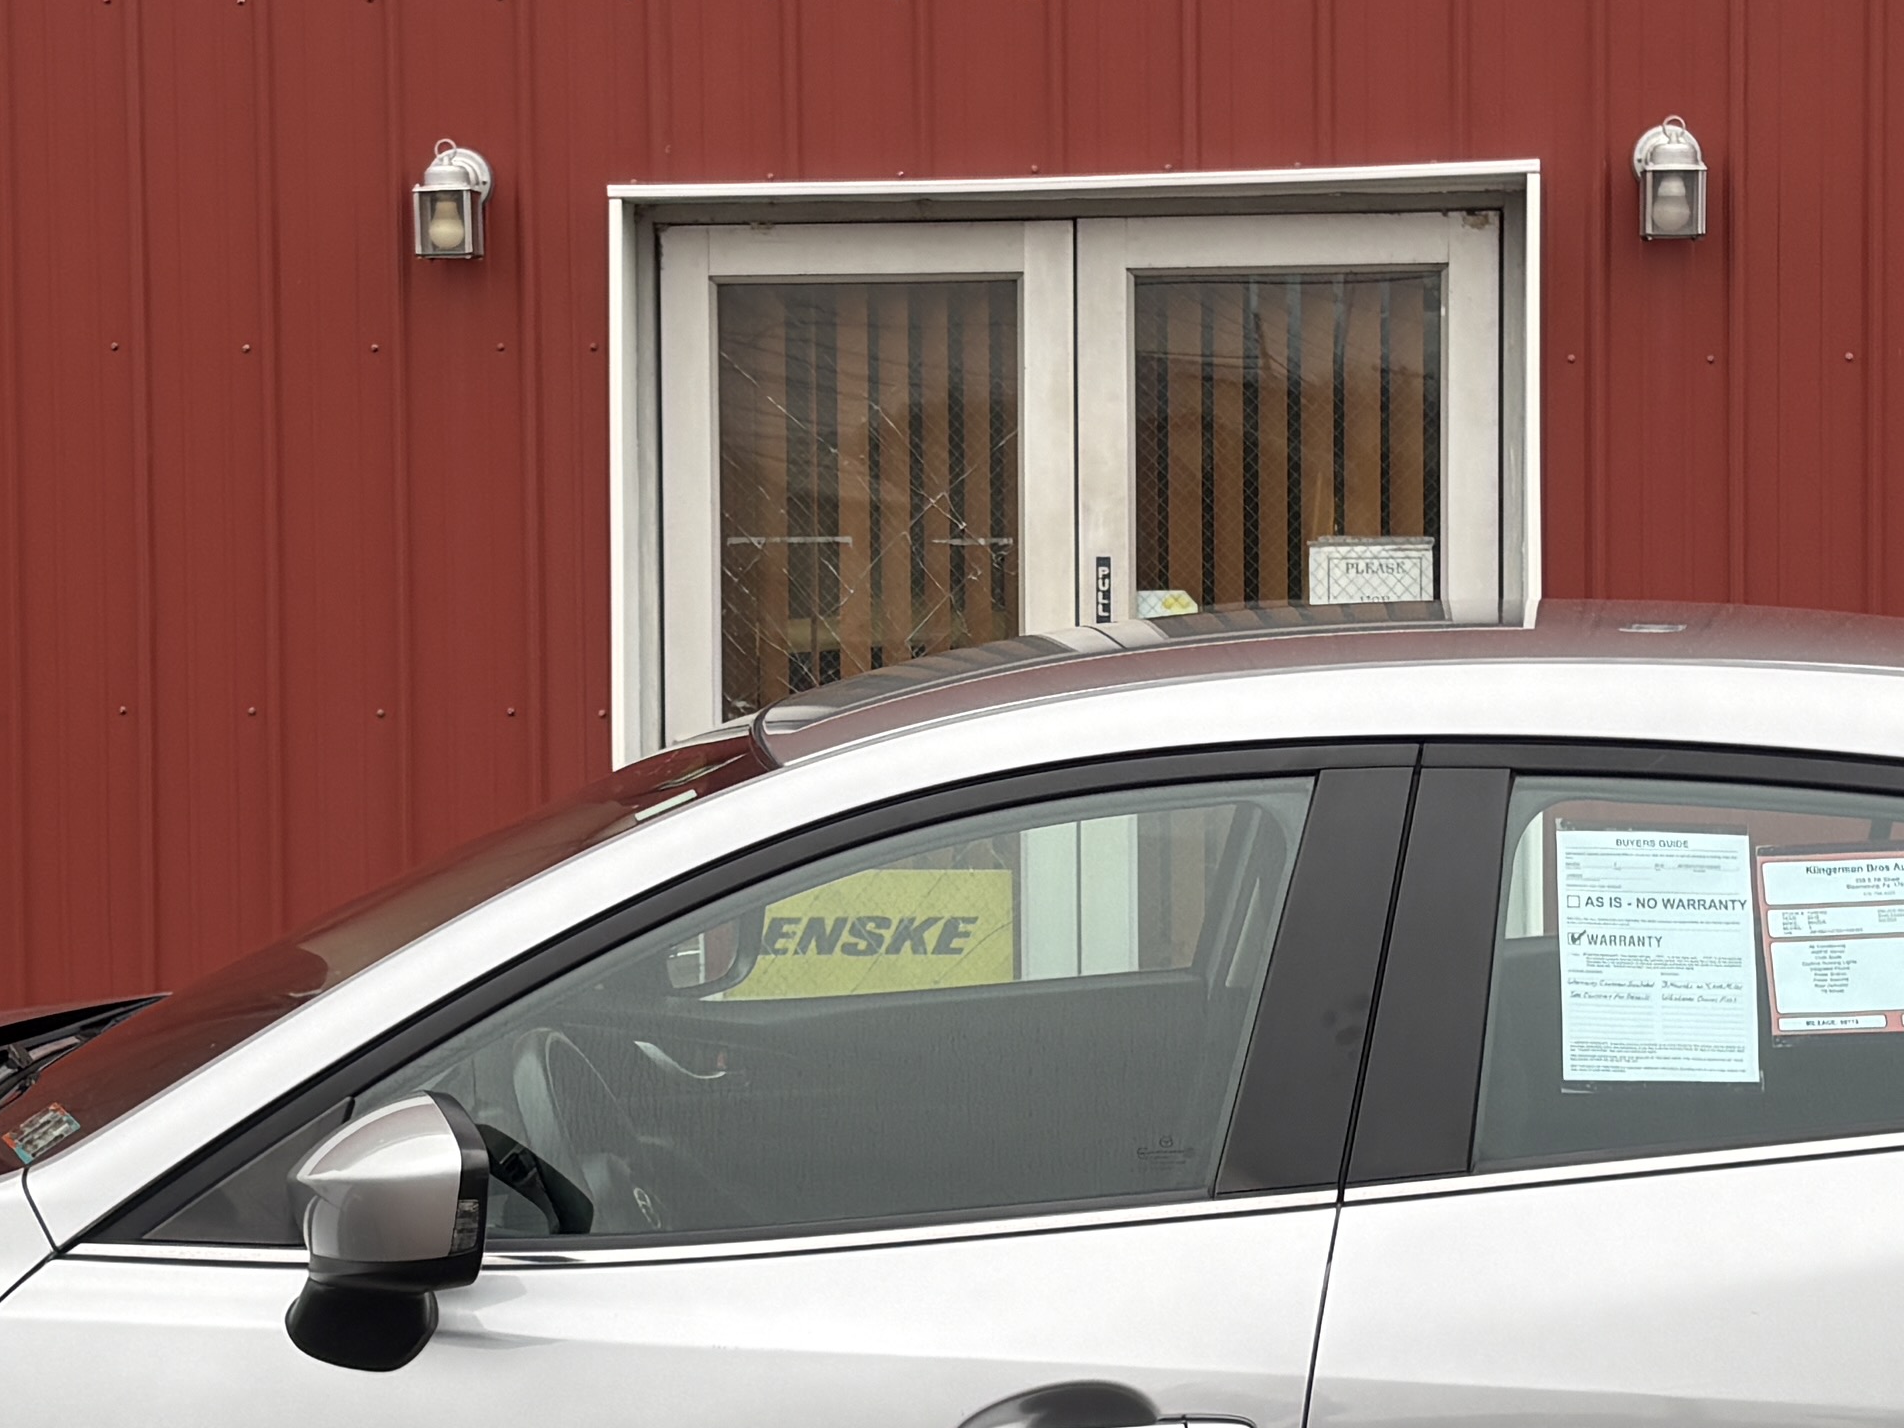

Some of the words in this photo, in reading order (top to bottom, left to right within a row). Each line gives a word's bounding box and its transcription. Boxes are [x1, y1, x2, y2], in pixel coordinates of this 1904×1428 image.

[1345, 560, 1406, 575] PLEASE
[1097, 566, 1110, 617] PULL
[1615, 838, 1656, 848] BUYERS
[1658, 839, 1690, 849] GUIDE
[1805, 865, 1864, 876] Klingerman
[1866, 863, 1891, 873] Bros
[1585, 896, 1604, 908] AS
[1609, 896, 1623, 909] IS
[1636, 897, 1658, 910] NO
[1662, 898, 1748, 911] WARRANTY
[761, 915, 980, 957] ENSKE
[1586, 933, 1663, 948] WARRANTY
